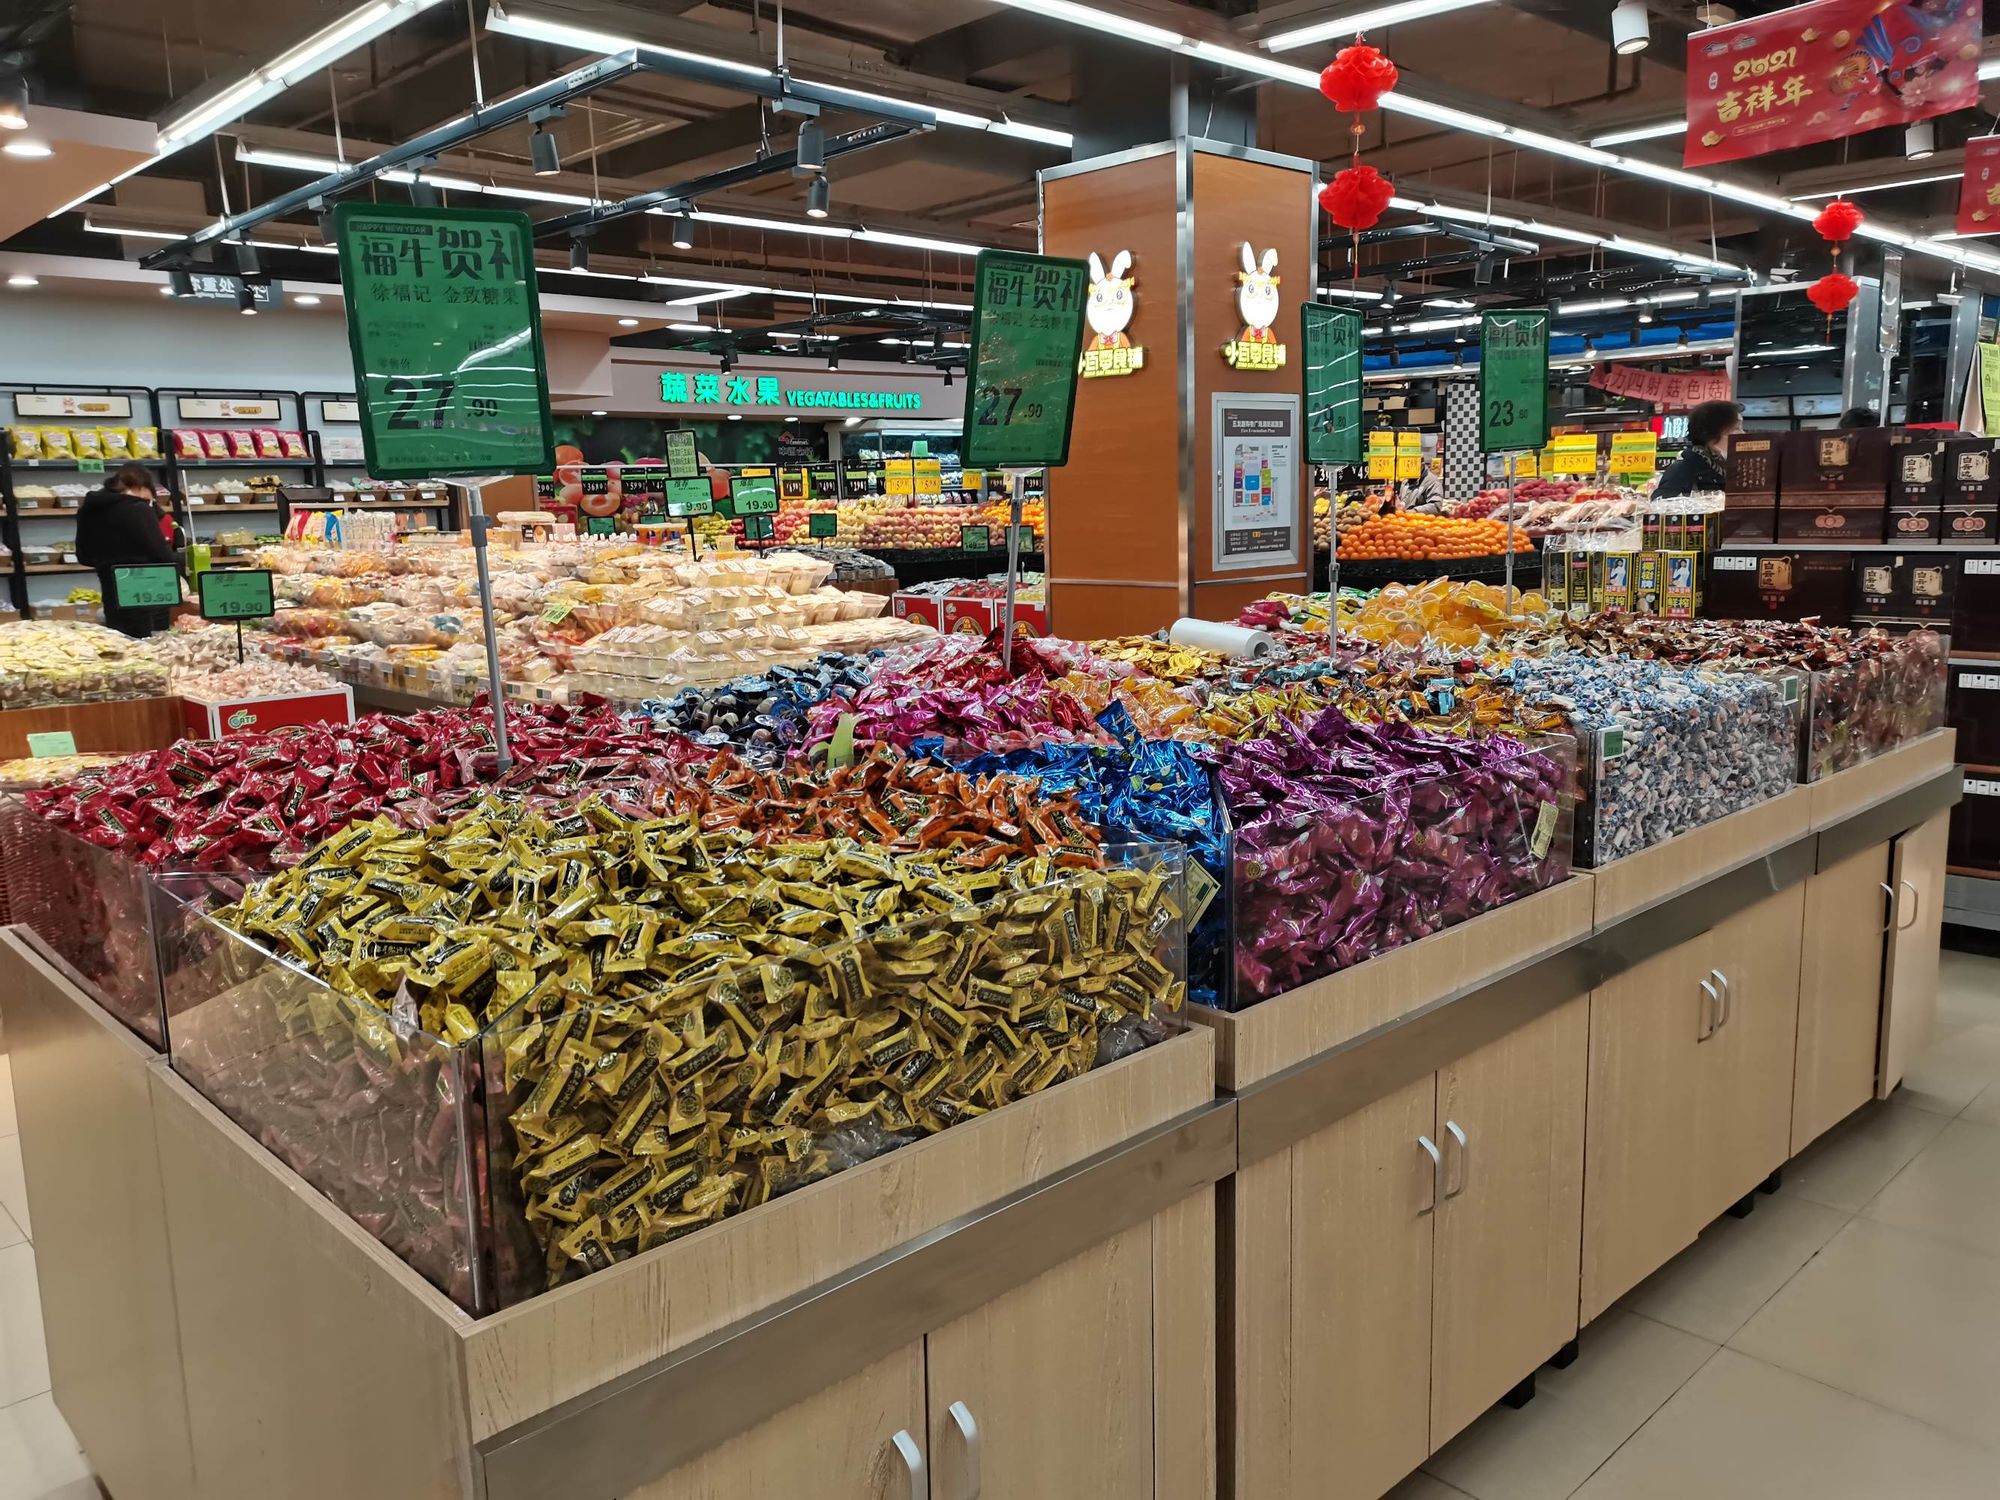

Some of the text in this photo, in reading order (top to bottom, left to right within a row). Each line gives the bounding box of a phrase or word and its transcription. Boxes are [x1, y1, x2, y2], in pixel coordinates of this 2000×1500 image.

[1732, 46, 1797, 83] 2021
[1716, 75, 1814, 124] 吉祥年
[356, 224, 427, 235] HAPPY NEW YEAR
[360, 227, 526, 281] 福牛贺礼
[372, 282, 431, 303] 徐福记
[987, 267, 1082, 312] 福牛贺礼
[660, 371, 781, 405] 蔬菜水果
[786, 390, 922, 410] VEGATABLES&FRUITS
[746, 500, 774, 511] 19.90
[132, 592, 172, 604] 19.90
[219, 601, 263, 615] 19.90
